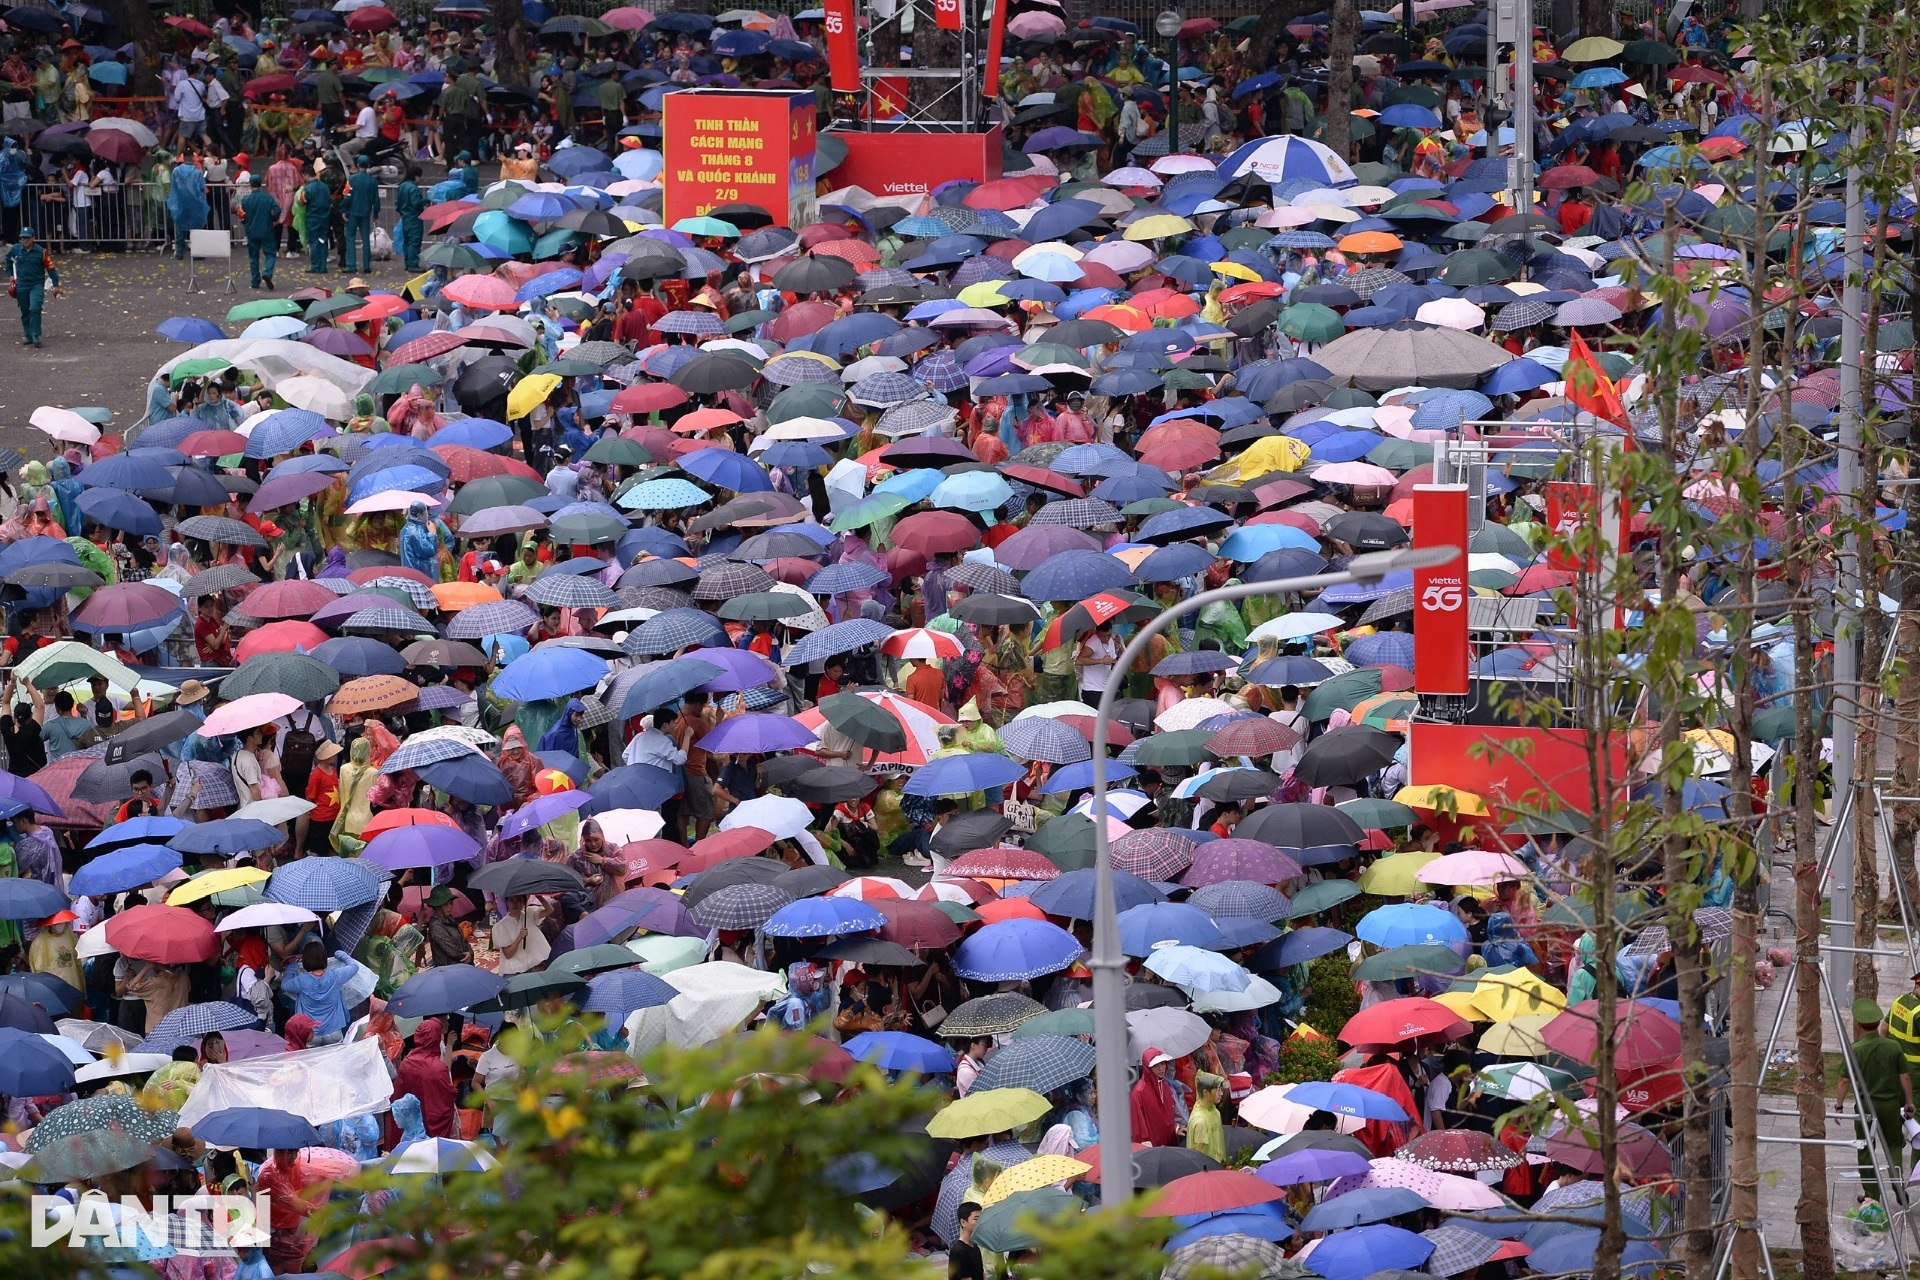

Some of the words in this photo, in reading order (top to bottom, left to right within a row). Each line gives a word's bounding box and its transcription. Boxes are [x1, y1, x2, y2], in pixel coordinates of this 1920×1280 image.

[826, 16, 843, 34] 5G
[694, 119, 724, 131] TINH
[726, 117, 759, 131] THẦN
[690, 135, 724, 148] CÁCH
[727, 137, 764, 151] MẠNG
[700, 153, 742, 166] THÁNG
[744, 155, 754, 166] 8
[677, 169, 694, 182] VÀ
[697, 168, 732, 183] QUỐC
[734, 171, 776, 184] KHÁNH
[883, 182, 930, 193] viettel
[715, 188, 739, 201] 2/9
[1429, 577, 1462, 585] viettel
[1421, 586, 1463, 612] 5G
[1340, 1105, 1356, 1113] UOB
